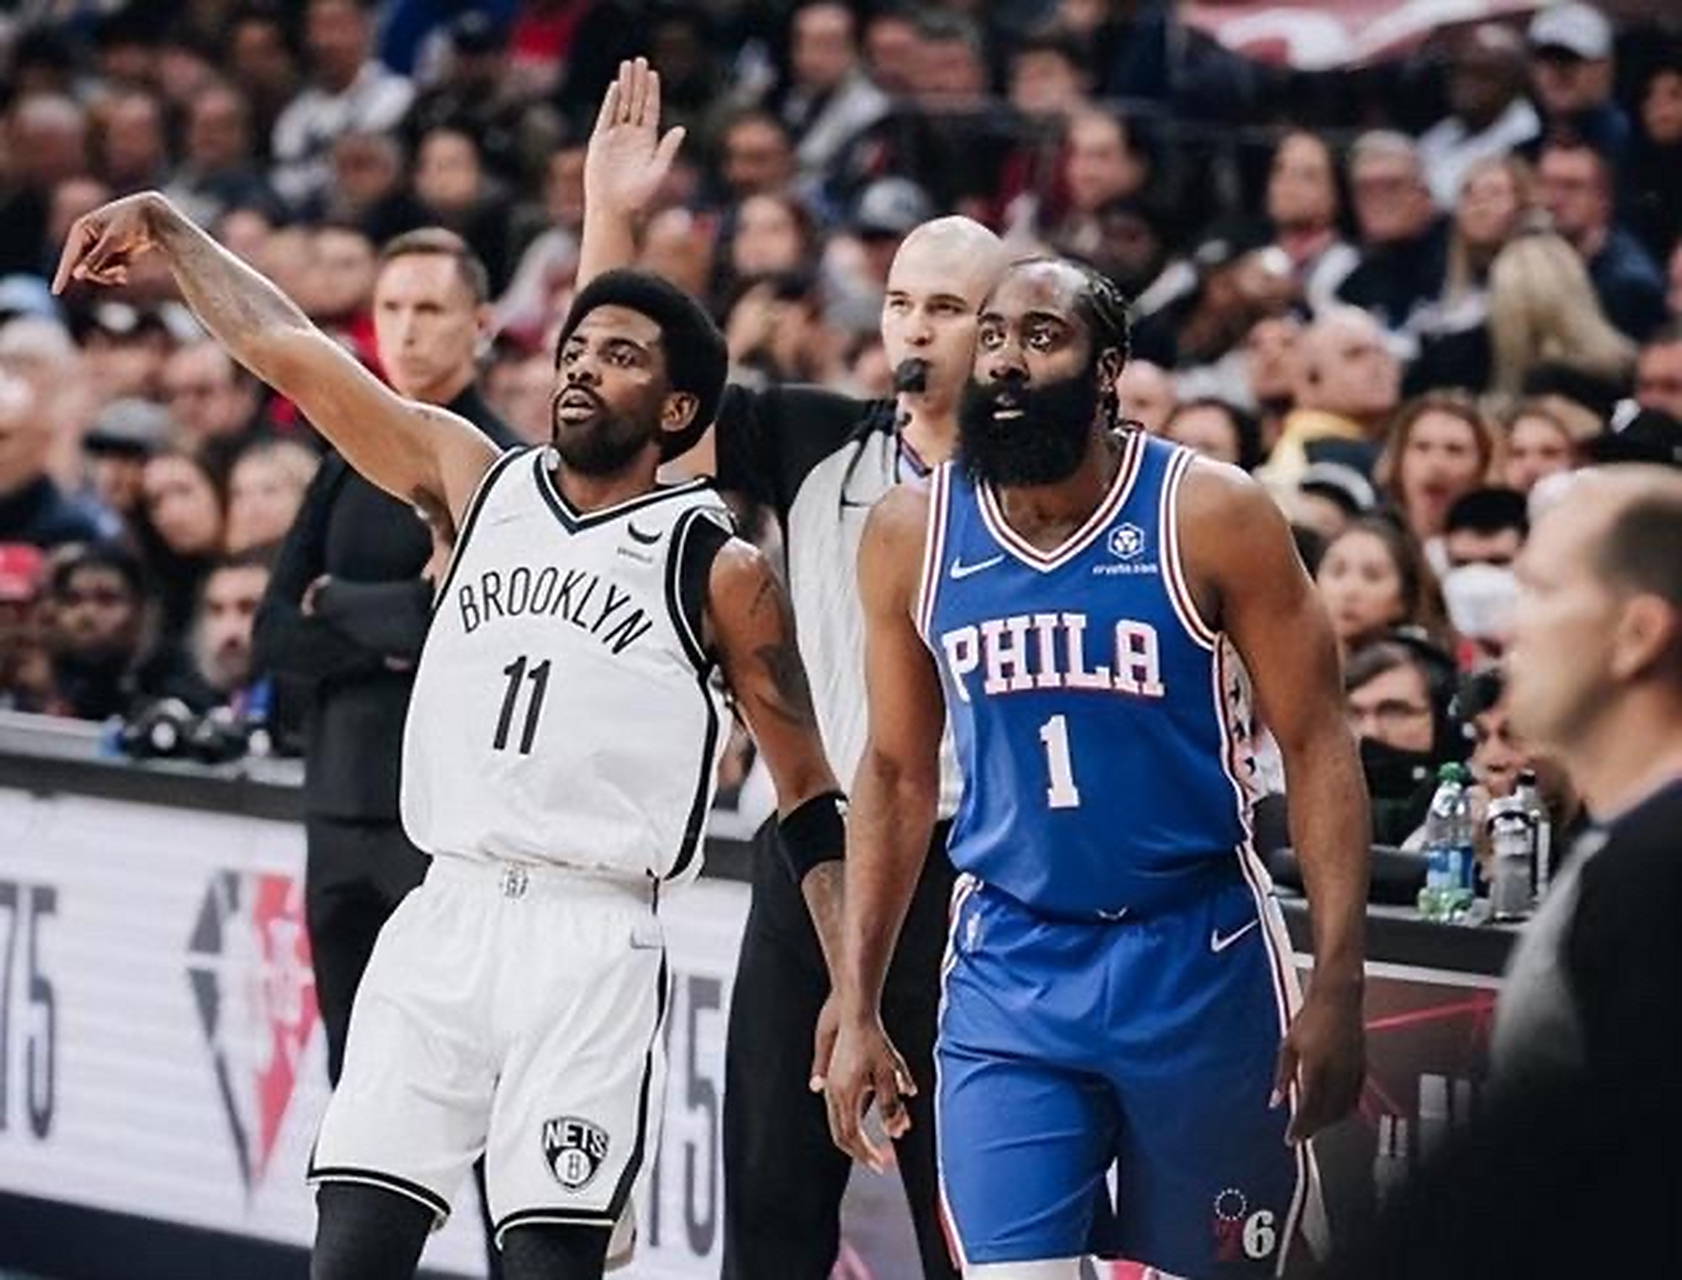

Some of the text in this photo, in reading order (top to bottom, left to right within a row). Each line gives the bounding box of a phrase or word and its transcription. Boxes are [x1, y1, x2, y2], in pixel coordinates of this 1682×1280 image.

[458, 566, 653, 655] BROOKLYN
[942, 612, 1165, 701] PHILA
[493, 655, 550, 754] 11
[1039, 714, 1079, 808] 1
[544, 1120, 608, 1158] NETS
